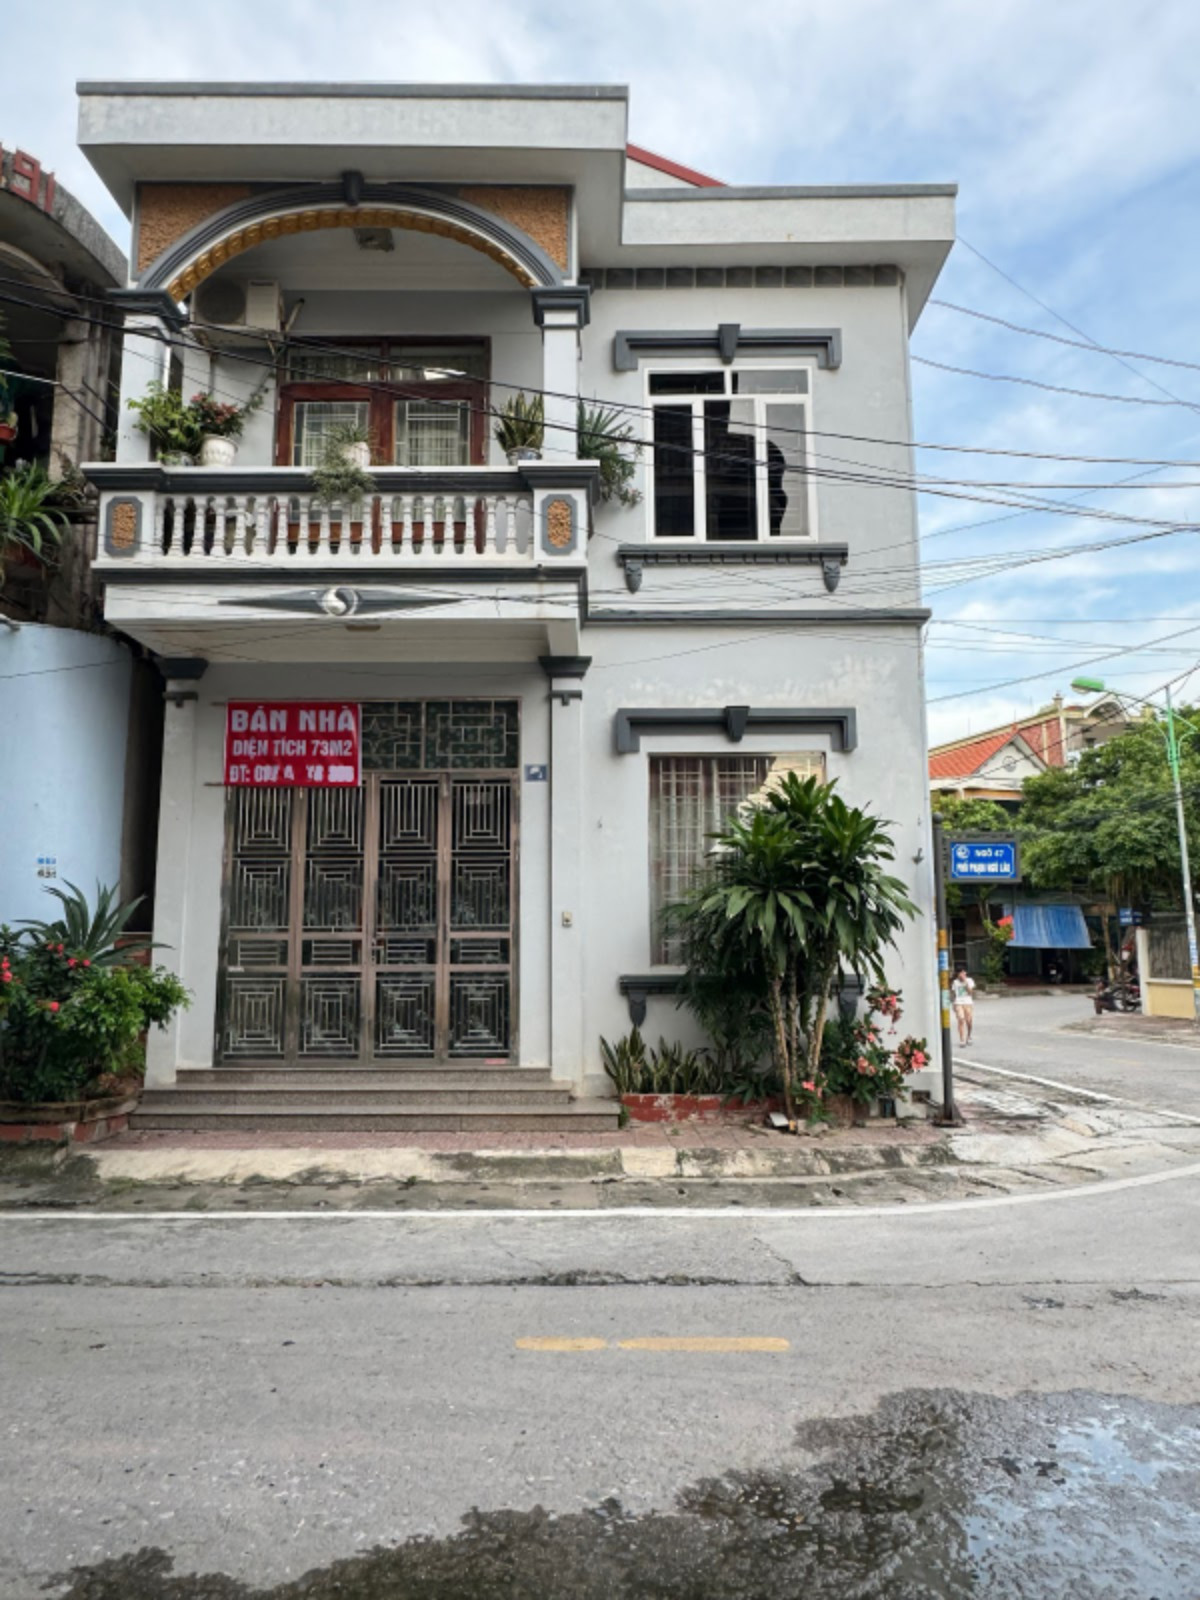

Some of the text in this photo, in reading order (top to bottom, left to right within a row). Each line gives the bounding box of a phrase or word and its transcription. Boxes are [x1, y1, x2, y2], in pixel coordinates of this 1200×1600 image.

[0, 141, 55, 213] 91
[231, 706, 354, 732] BÁN NHÀ
[233, 736, 353, 758] DIỆN TÍCH 73M2
